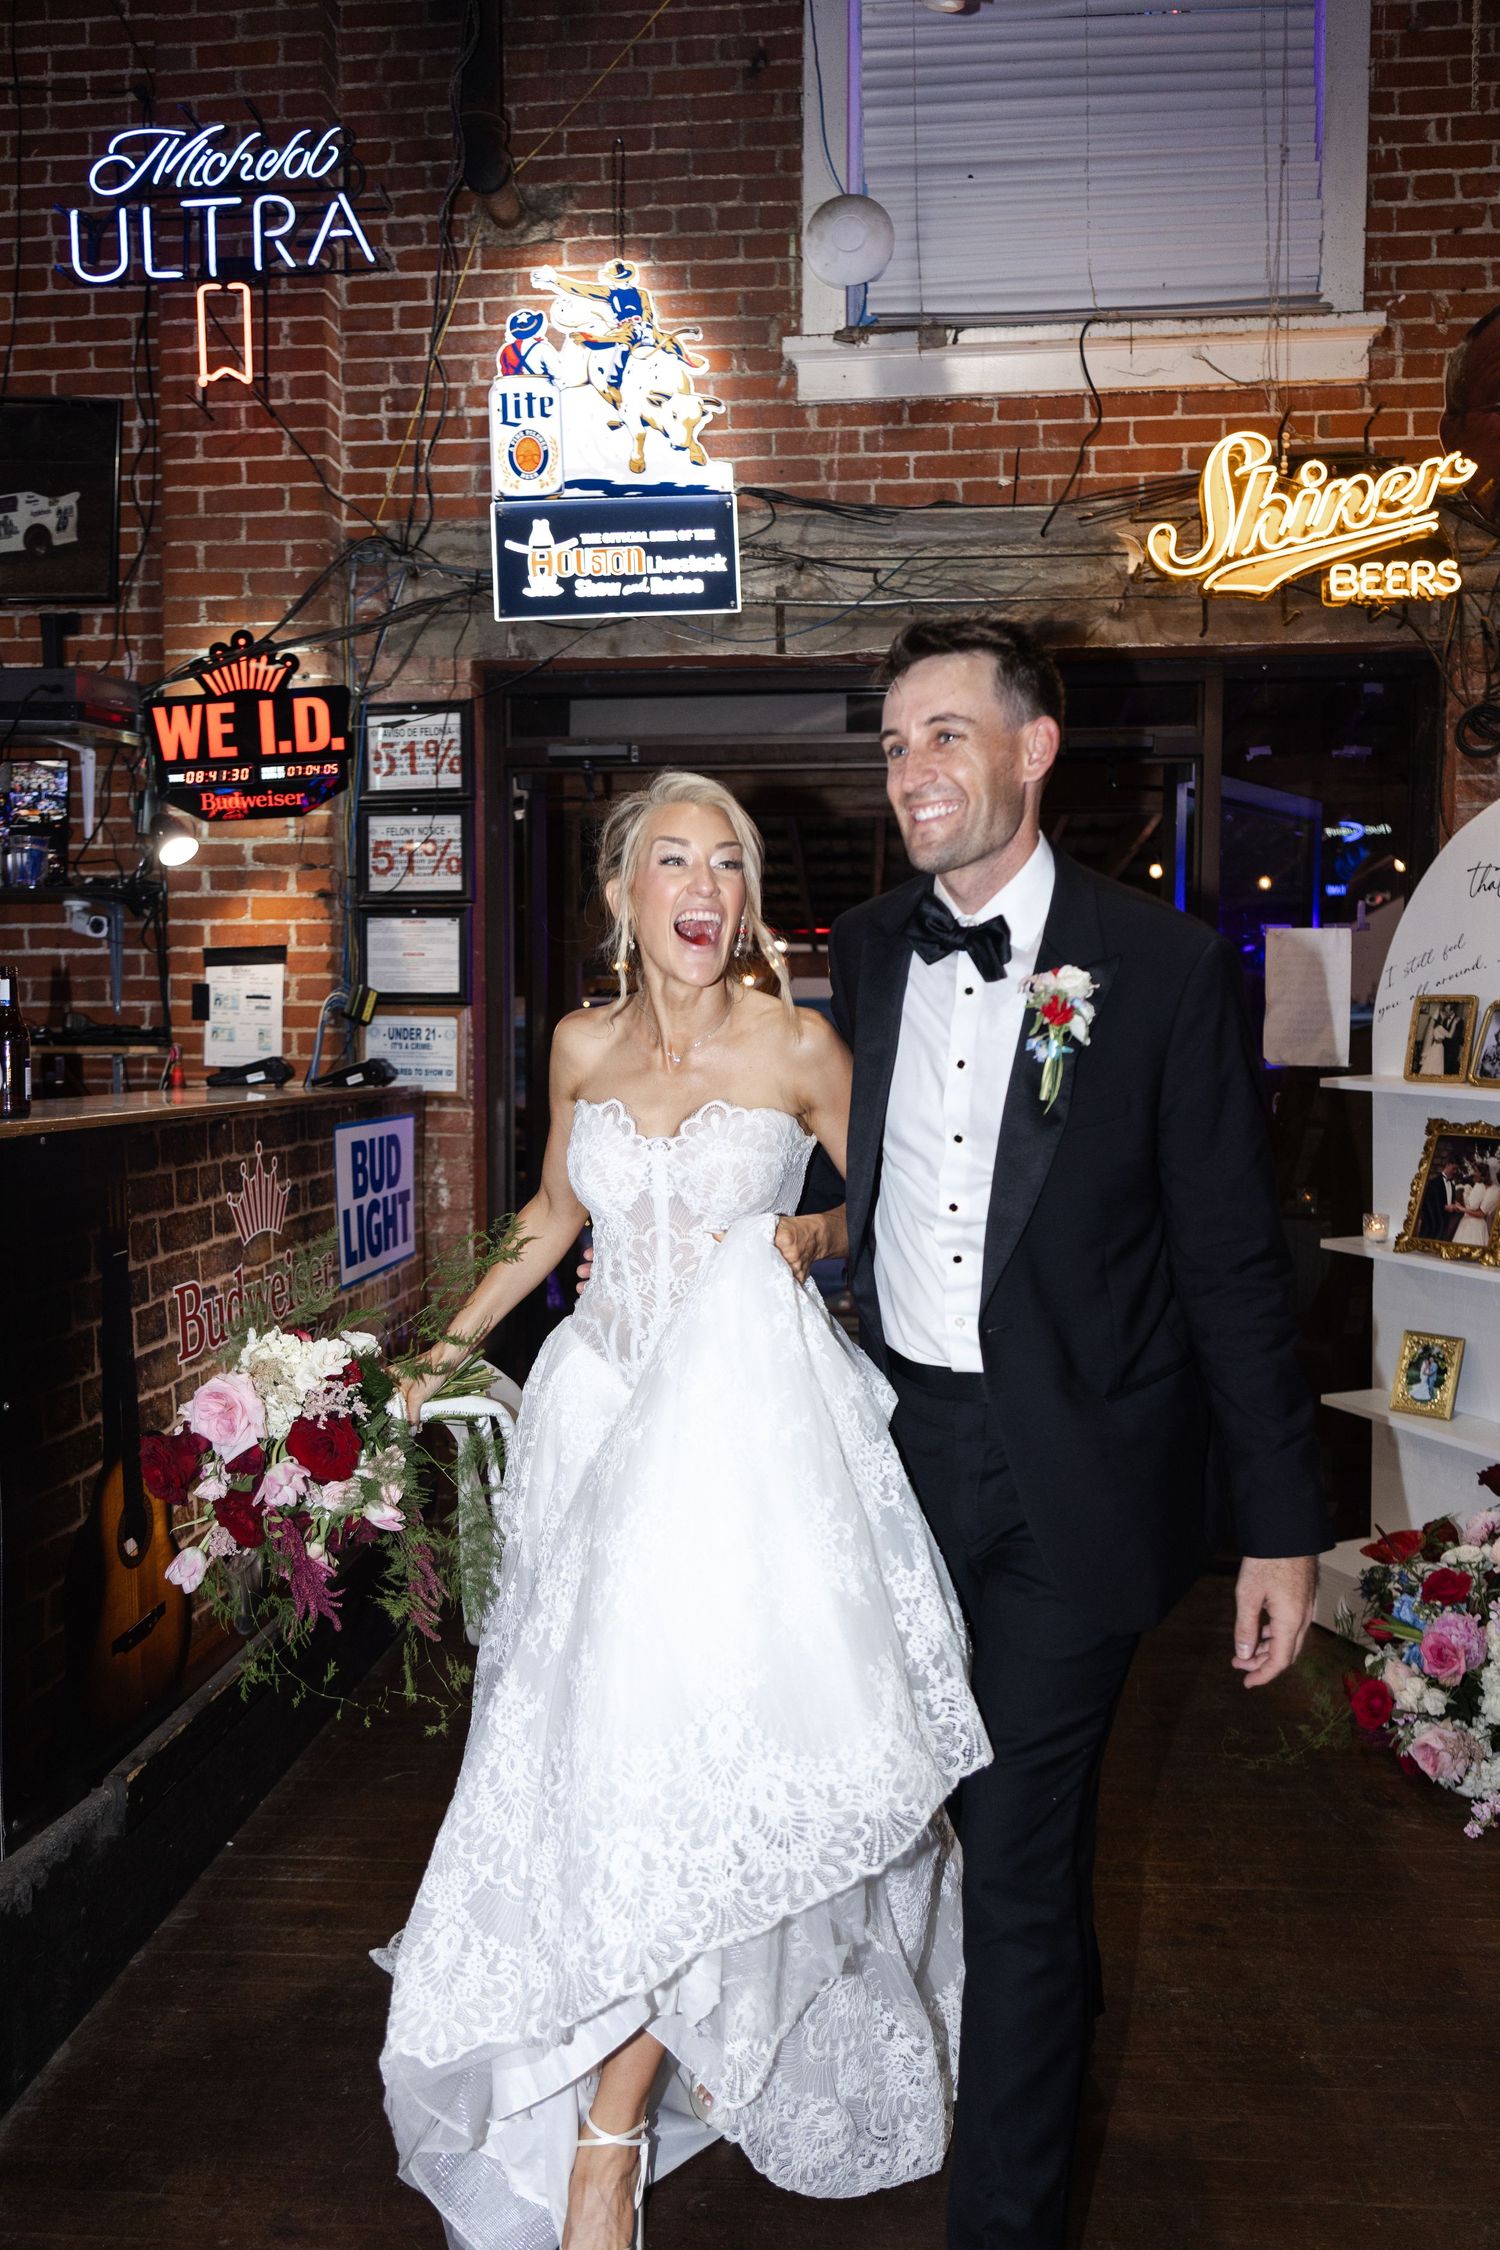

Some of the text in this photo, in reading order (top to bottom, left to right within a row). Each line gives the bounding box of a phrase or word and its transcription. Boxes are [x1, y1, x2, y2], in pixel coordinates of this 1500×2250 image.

[89, 124, 342, 196] Michelob
[70, 192, 377, 283] ULTRA
[499, 392, 554, 427] Lite
[1147, 431, 1479, 576] Shiner
[1329, 560, 1463, 598] BEERS
[152, 696, 345, 761] WE I.D.
[407, 728, 418, 737] DE
[373, 738, 462, 777] 51%
[200, 790, 306, 812] Budweiser
[386, 827, 415, 836] FELONY
[371, 838, 462, 877] 51%
[1467, 861, 1500, 898] tha
[1403, 949, 1435, 979] still
[1377, 1001, 1400, 1023] you
[388, 1028, 436, 1041] UNDER 21
[414, 1068, 424, 1077] TO
[351, 1134, 401, 1200] BUD
[342, 1188, 411, 1269] LIGHT
[172, 1249, 334, 1366] Budweier
